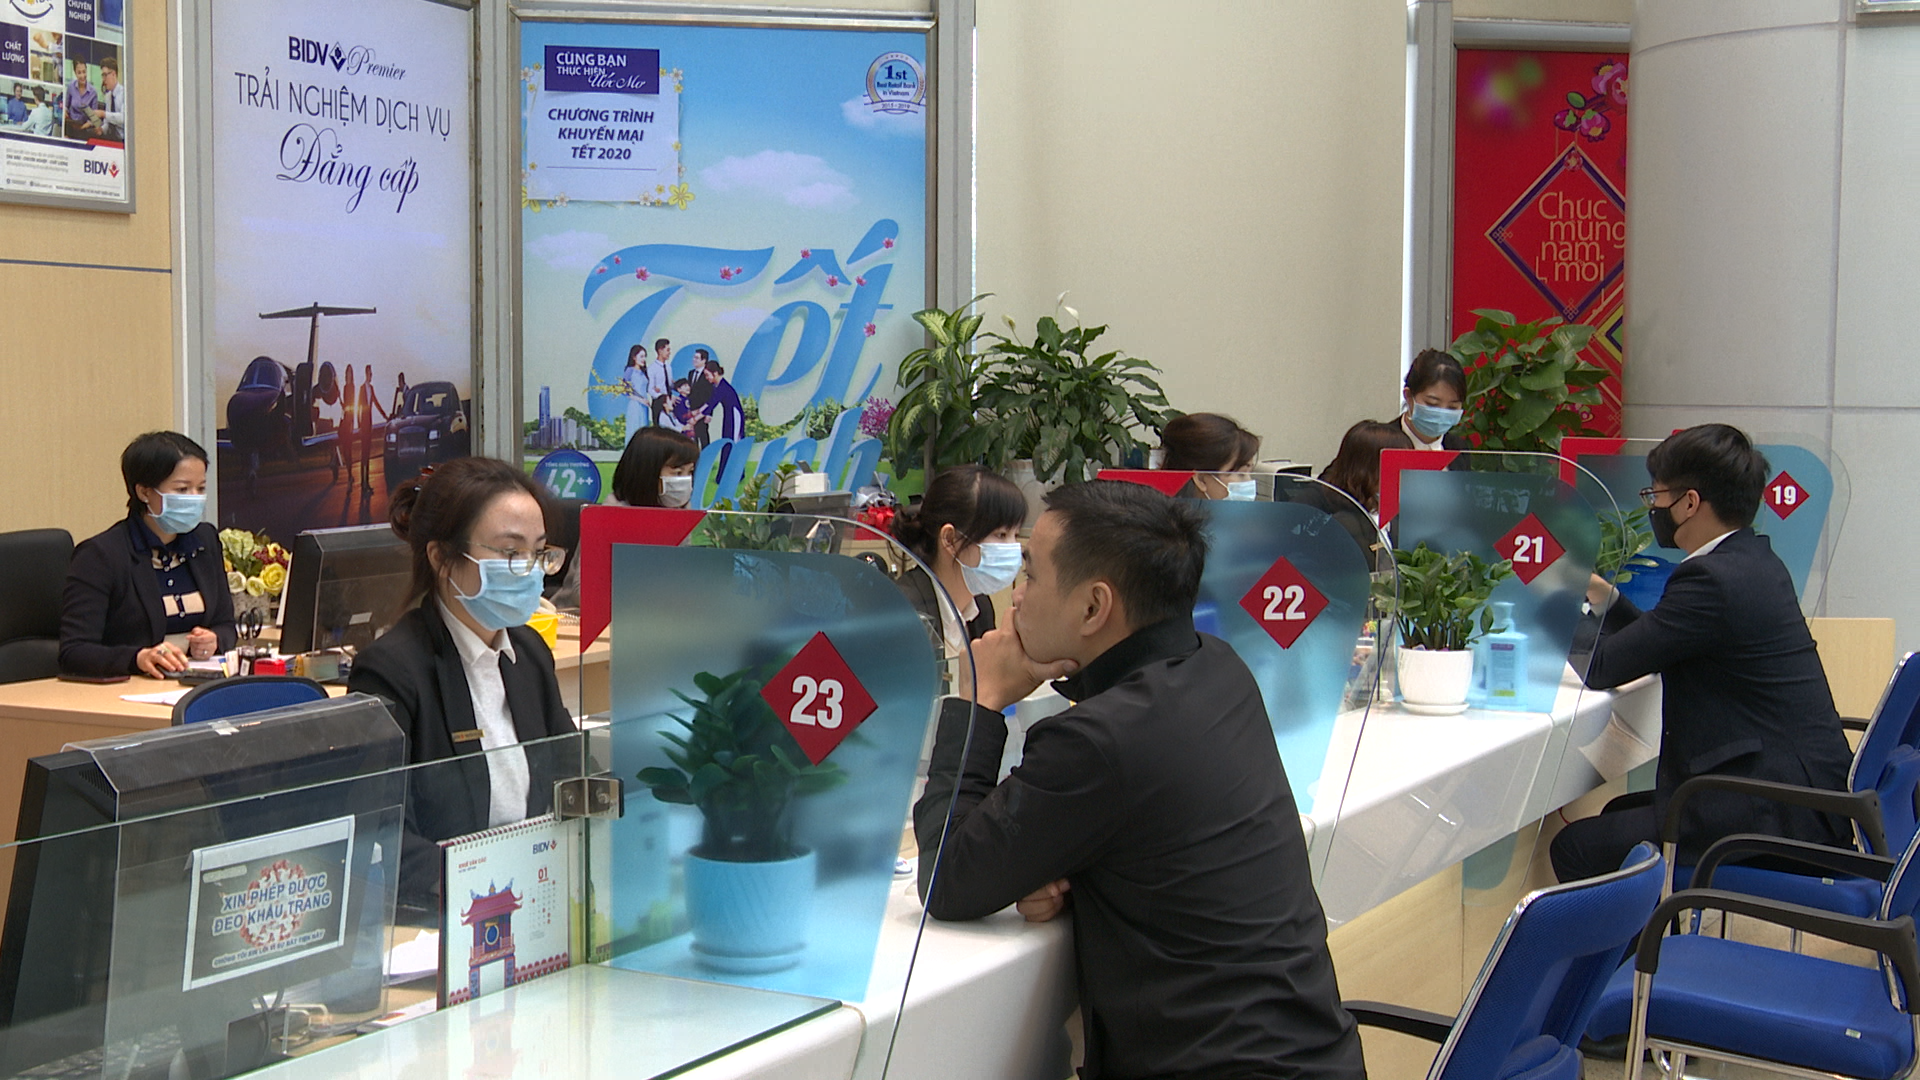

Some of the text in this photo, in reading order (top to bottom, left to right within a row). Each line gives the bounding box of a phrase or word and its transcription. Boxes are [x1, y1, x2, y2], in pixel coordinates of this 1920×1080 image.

[69, 11, 91, 23] NGHIỆP
[5, 40, 22, 50] CHẤT
[2, 52, 25, 63] LƯỢNG
[288, 36, 406, 80] BIDV Premier
[556, 51, 627, 68] CÙNG BẠN
[556, 66, 581, 77] THỰC
[885, 65, 908, 80] 1st
[235, 66, 450, 141] TRẢI NGHIỆM DỊCH VỤ
[548, 108, 654, 123] CHƯƠNG TRÌNH
[558, 125, 644, 145] KHUYẾN MẠI
[571, 144, 632, 160] TẾT 2020
[84, 159, 109, 175] BIDV
[276, 123, 419, 214] Đẳng cấp
[582, 218, 899, 425] Tết
[1772, 486, 1796, 504] 19
[1513, 535, 1544, 563] 21
[1263, 585, 1306, 620] 22
[790, 675, 844, 729] 23
[533, 841, 550, 854] BIDV
[538, 867, 548, 879] 01
[223, 874, 326, 910] XIN PHÉP ĐƯỢC
[214, 915, 243, 933] ĐEO
[288, 892, 330, 914] TRANG
